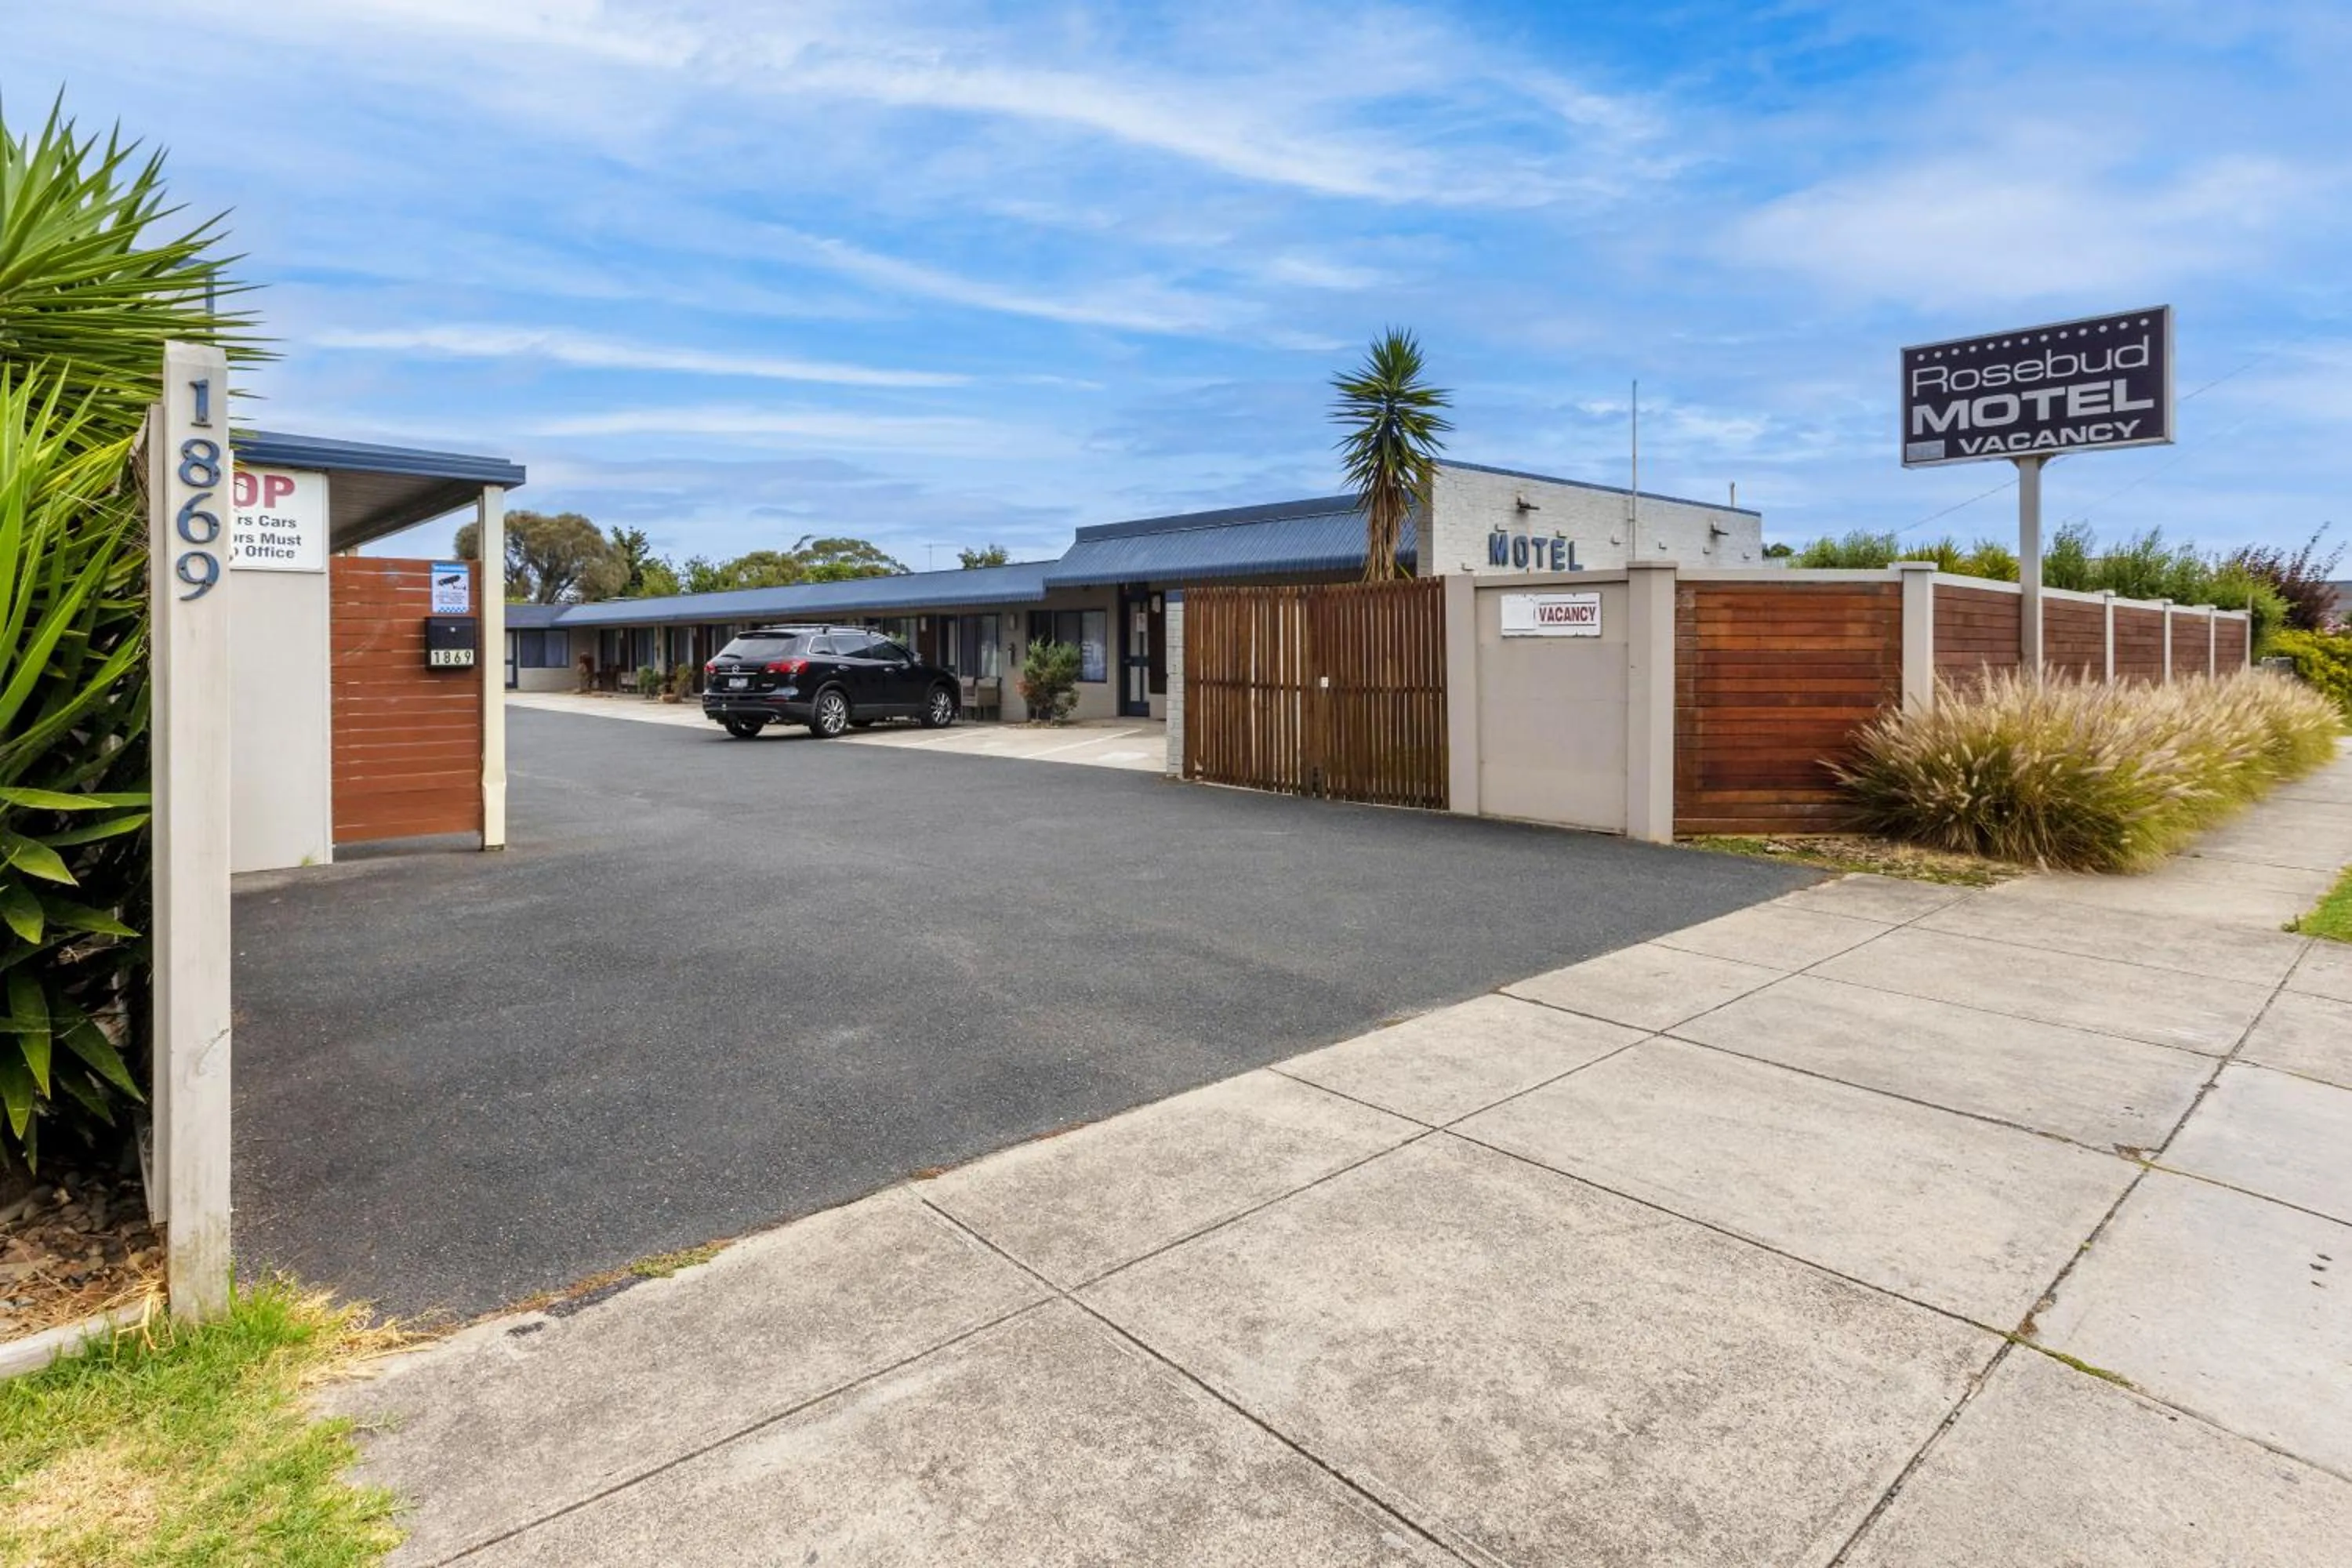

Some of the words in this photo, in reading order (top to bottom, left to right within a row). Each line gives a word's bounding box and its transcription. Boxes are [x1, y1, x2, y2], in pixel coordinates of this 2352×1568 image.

[1912, 335, 2149, 397] Rosebud
[1912, 379, 2154, 435] MOTEL
[1958, 419, 2141, 455] VACANCY
[176, 379, 221, 602] 1869
[259, 515, 297, 528] Cars
[245, 545, 296, 558] Office
[260, 532, 302, 546] Must
[1489, 532, 1584, 571] MOTEL
[1539, 606, 1596, 622] VACANCY
[434, 652, 470, 664] 1869
